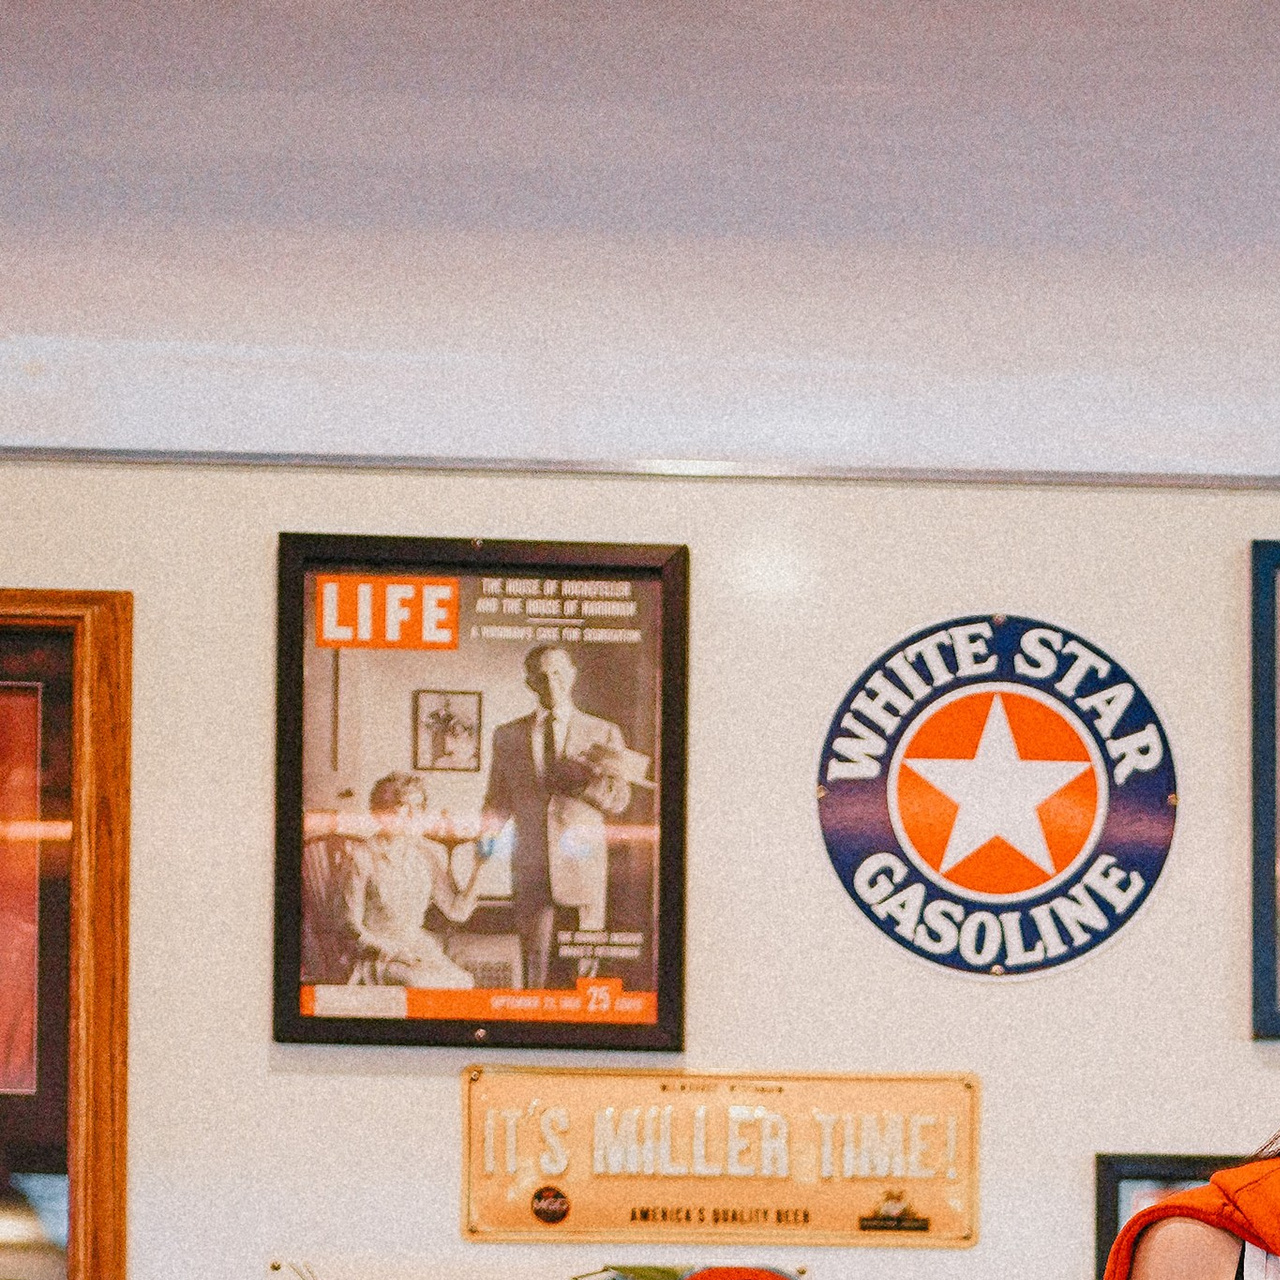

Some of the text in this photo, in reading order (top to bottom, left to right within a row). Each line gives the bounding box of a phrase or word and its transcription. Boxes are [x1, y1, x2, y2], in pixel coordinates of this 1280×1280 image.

[322, 583, 453, 643] LIFE
[827, 622, 1163, 785] WHITE STAR
[852, 852, 1145, 967] GASOLINE
[586, 986, 611, 1012] 25
[484, 1098, 958, 1180] IT'S MILLER TIME!
